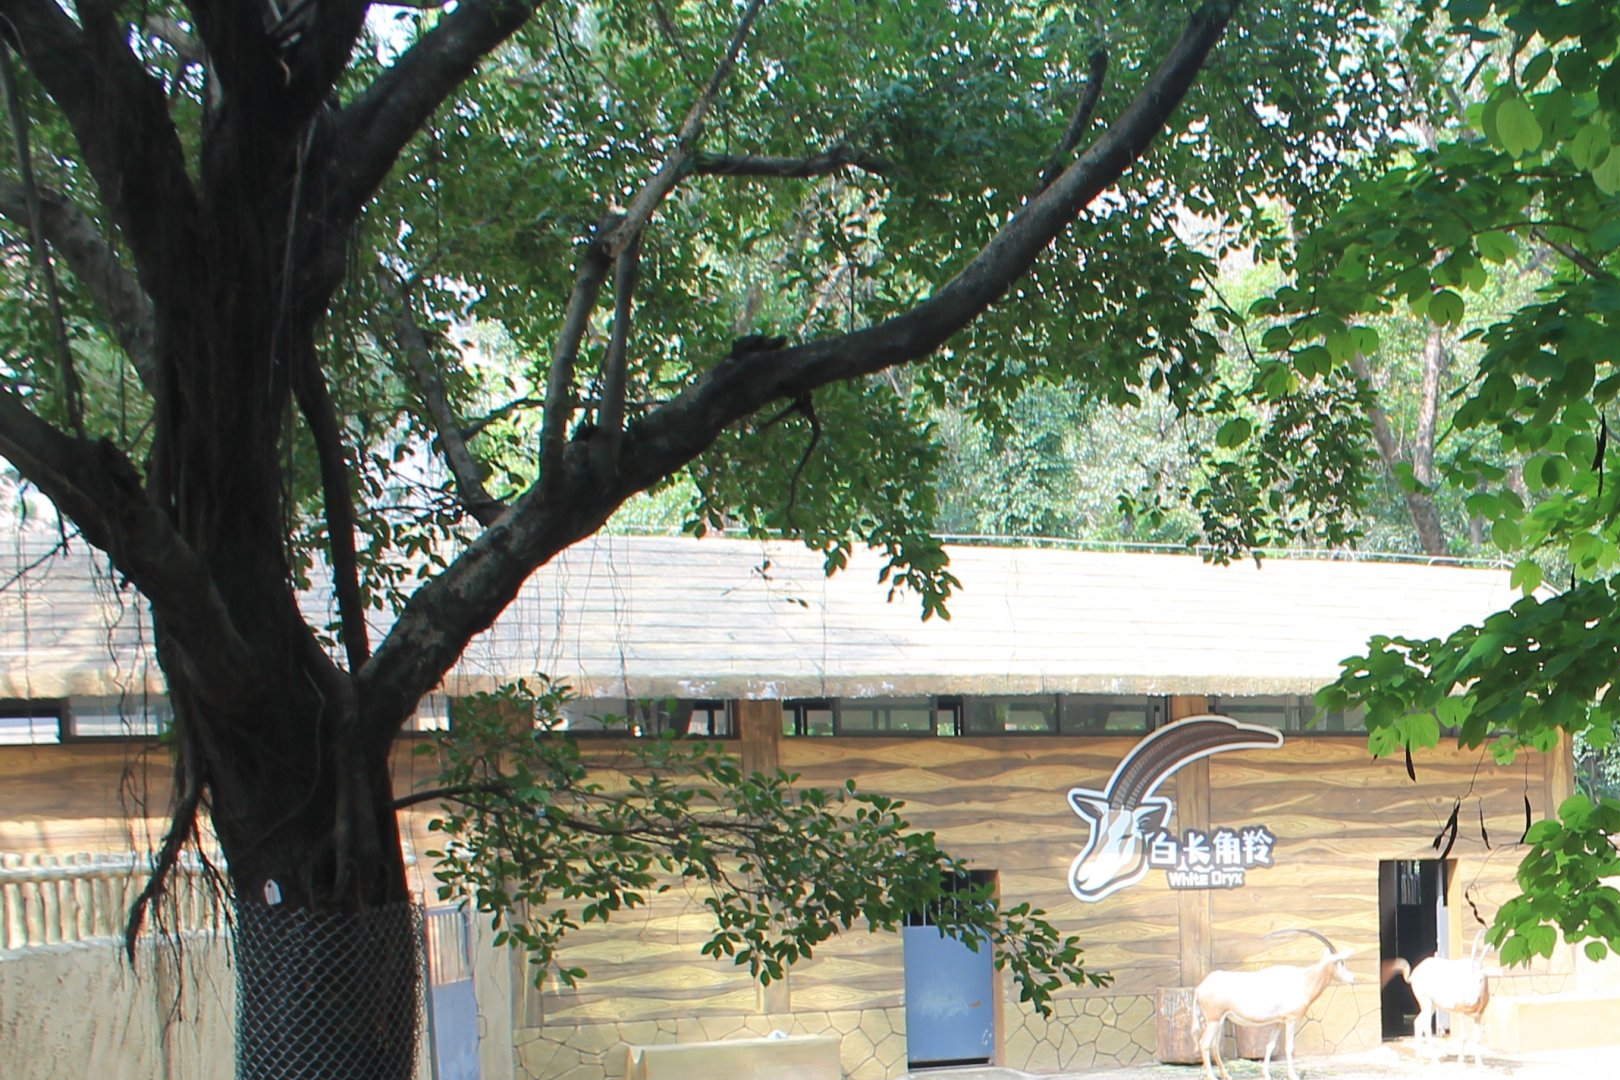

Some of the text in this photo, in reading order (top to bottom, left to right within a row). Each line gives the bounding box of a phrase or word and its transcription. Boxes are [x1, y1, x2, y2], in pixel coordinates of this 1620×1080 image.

[1151, 829, 1273, 865] 白长角羚
[1168, 870, 1243, 886] White Oryx
